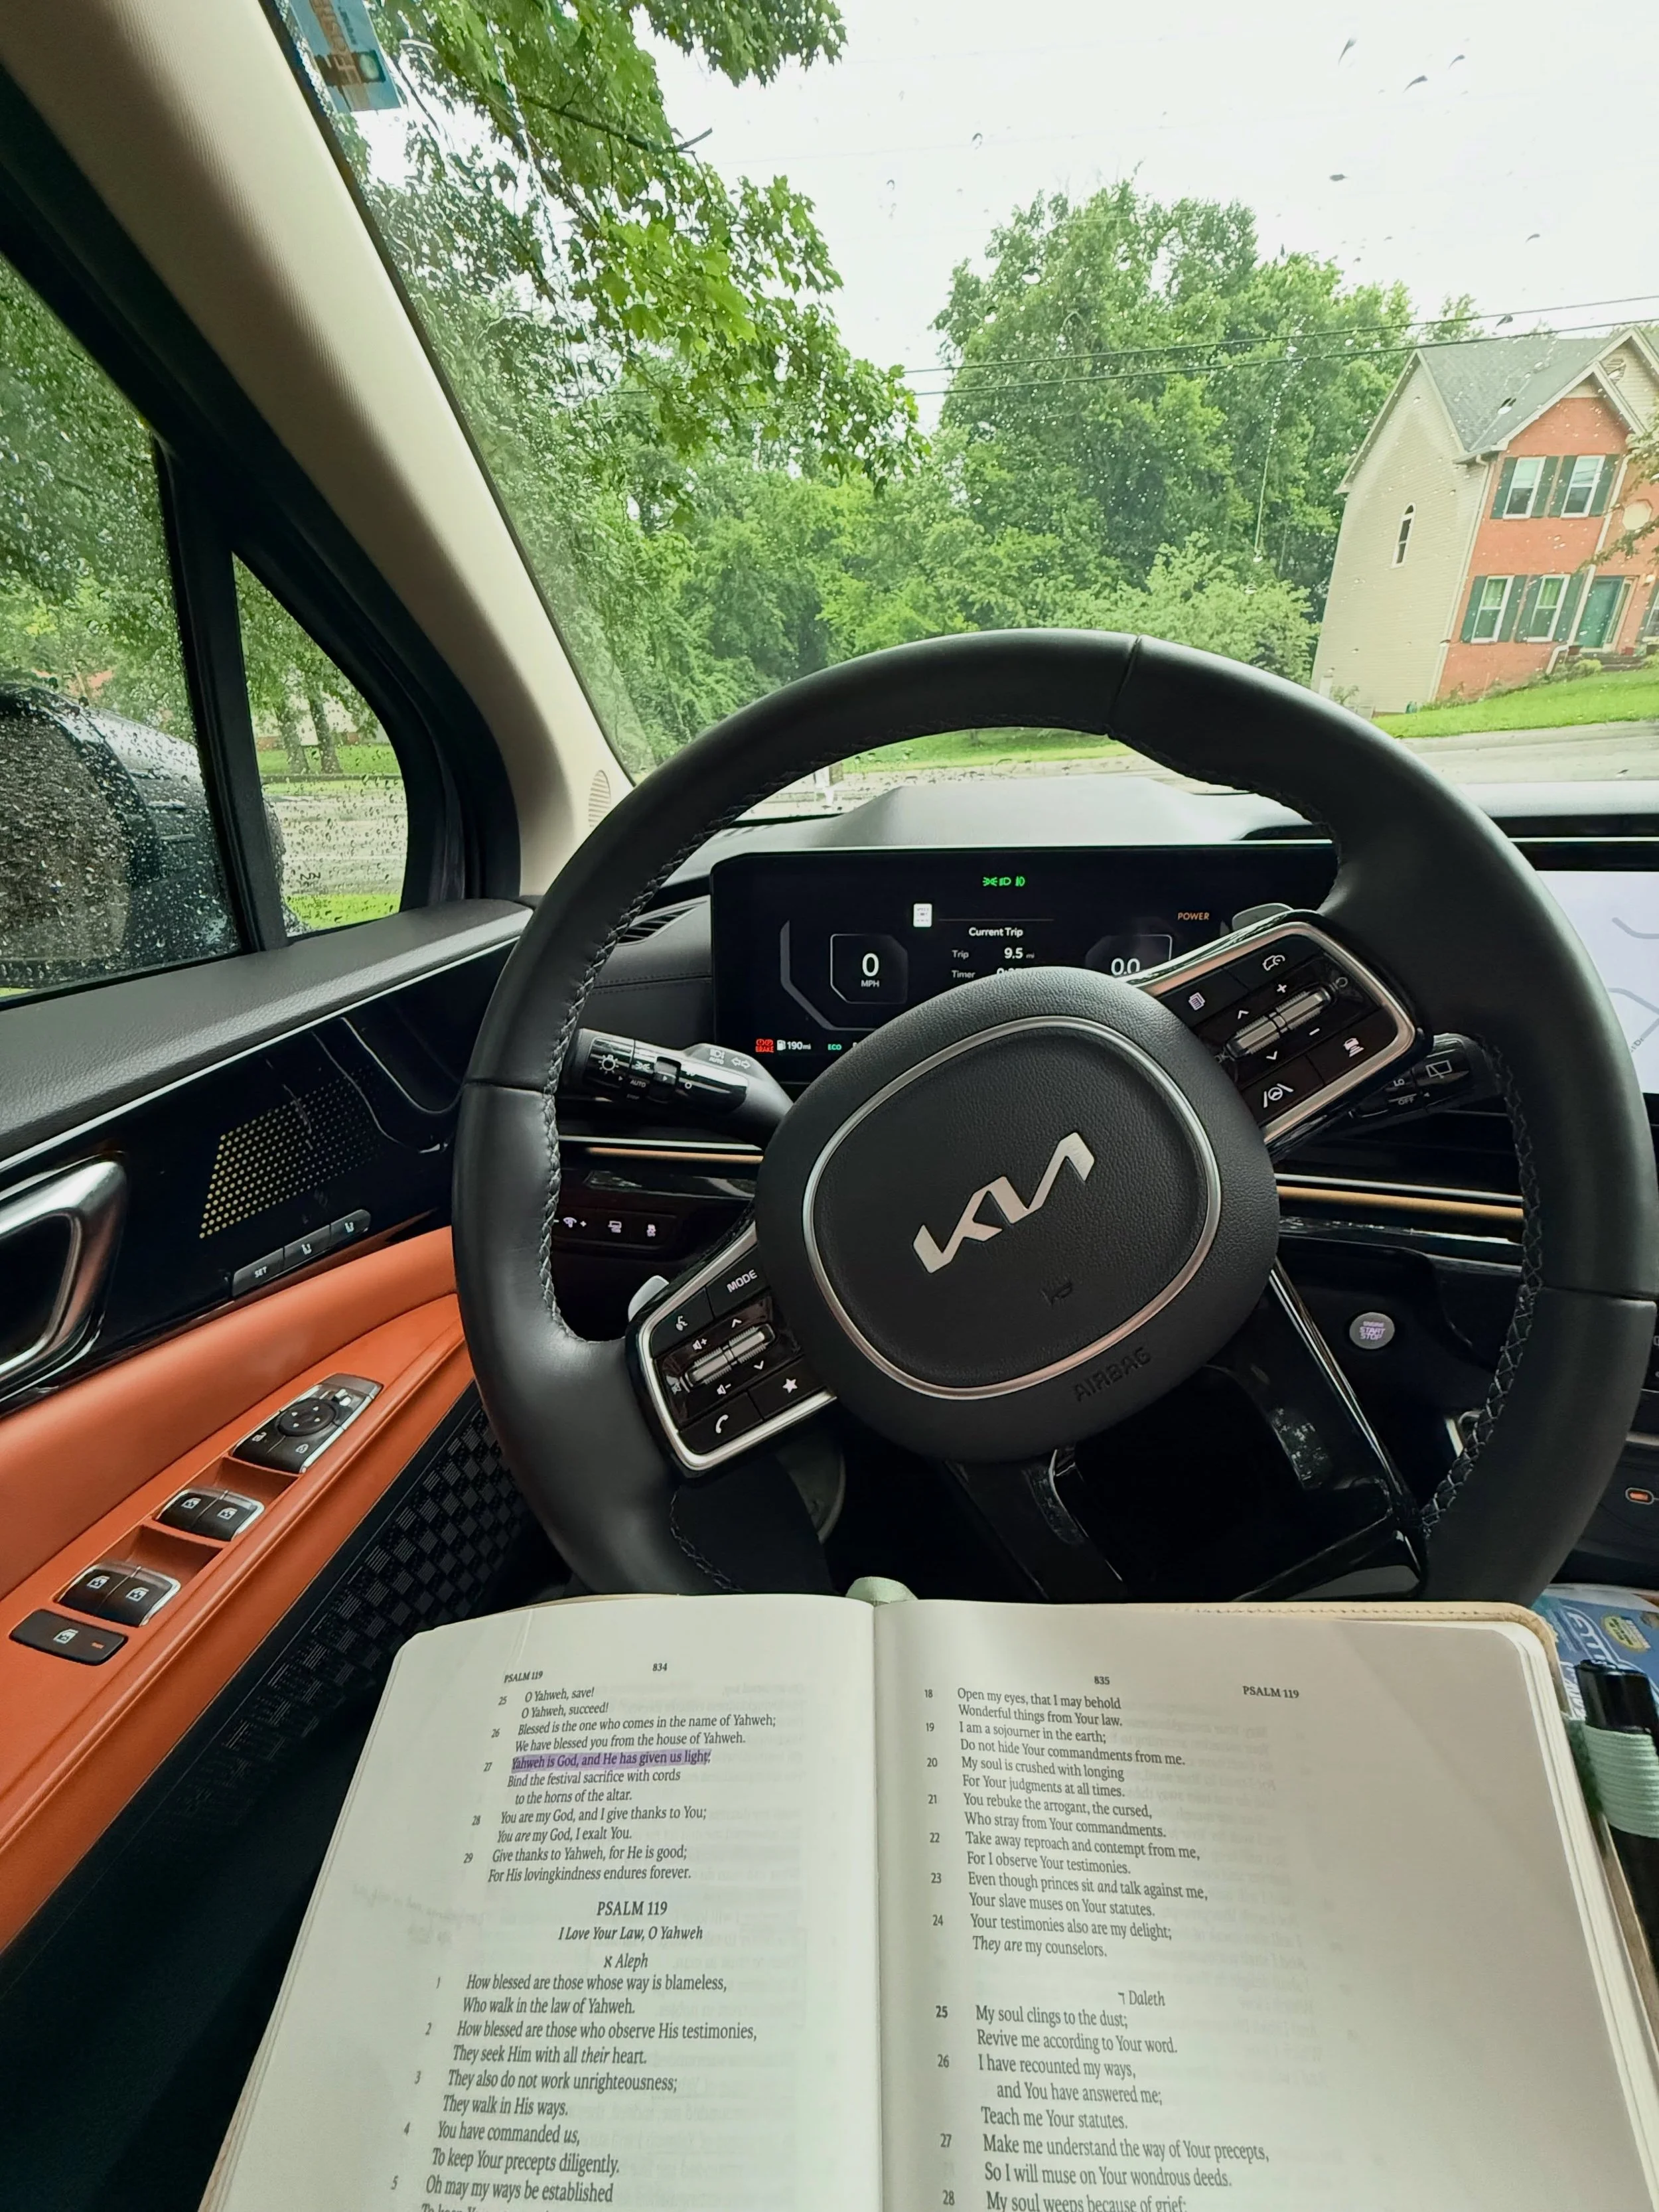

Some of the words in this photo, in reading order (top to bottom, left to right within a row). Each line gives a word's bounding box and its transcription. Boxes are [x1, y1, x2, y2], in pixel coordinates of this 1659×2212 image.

[1177, 912, 1210, 921] POWER
[968, 927, 1003, 936] Current
[1004, 927, 1023, 938] Trip
[952, 950, 969, 960] Trip
[1003, 947, 1023, 960] 9.5
[862, 952, 879, 977] 0
[1110, 958, 1141, 976] 0.0
[952, 970, 975, 979] Timer
[861, 979, 880, 988] MPH
[709, 1057, 725, 1065] AUTO
[630, 1079, 647, 1088] AUTO
[254, 1266, 267, 1278] SET
[726, 1269, 758, 1293] MODE
[1074, 1346, 1152, 1402] AIRBAG
[652, 1662, 668, 1672] 834
[503, 1670, 531, 1684] PSALM
[531, 1670, 543, 1680] 119
[1094, 1675, 1110, 1686] 835
[498, 1696, 508, 1706] 25
[524, 1691, 533, 1703] O
[534, 1688, 569, 1702] Yahweh,
[571, 1686, 595, 1699] save!
[924, 1688, 934, 1698] 18
[957, 1687, 985, 1702] Open
[987, 1692, 1002, 1705] my
[1004, 1694, 1029, 1706] eyes,
[1030, 1692, 1052, 1706] that
[1053, 1694, 1058, 1706] I
[1060, 1698, 1082, 1710] may
[1084, 1695, 1122, 1710] behold
[1242, 1685, 1281, 1698] PSALM
[1283, 1689, 1299, 1699] 119
[490, 1728, 500, 1739] 26
[517, 1720, 551, 1736] Blessed
[551, 1720, 560, 1733] is
[561, 1720, 577, 1733] the
[579, 1721, 598, 1732] one
[599, 1718, 621, 1730] who
[622, 1719, 654, 1730] comes
[656, 1716, 667, 1728] in
[669, 1715, 686, 1728] the
[687, 1717, 718, 1728] name
[719, 1714, 732, 1727] of
[733, 1713, 776, 1728] Yahweh;
[926, 1722, 935, 1732] 19
[960, 1738, 976, 1751] Do
[977, 1741, 996, 1753] not
[997, 1739, 1020, 1755] hide
[1021, 1743, 1045, 1757] Your
[1047, 1747, 1133, 1762] commandments
[1134, 1749, 1163, 1764] from
[1164, 1755, 1185, 1765] me.
[483, 1761, 493, 1772] 27
[511, 1755, 545, 1771] Yahweh
[546, 1754, 555, 1769] is
[557, 1753, 579, 1769] God,
[581, 1752, 601, 1766] and
[602, 1752, 618, 1765] He
[618, 1751, 638, 1765] has
[638, 1751, 668, 1767] given
[670, 1753, 682, 1763] us
[926, 1757, 938, 1767] 20
[928, 1793, 937, 1805] 21
[963, 1792, 984, 1806] You
[986, 1794, 1022, 1809] rebuke
[1024, 1796, 1041, 1810] the
[1043, 1801, 1090, 1816] arrogant,
[1092, 1801, 1110, 1815] the
[1112, 1804, 1153, 1819] cursed,
[471, 1815, 481, 1826] 28
[929, 1832, 940, 1843] 22
[965, 1830, 992, 1846] Take
[995, 1835, 1021, 1850] away
[1023, 1836, 1070, 1852] reproach
[1072, 1838, 1092, 1852] and
[1094, 1842, 1146, 1859] contempt
[1147, 1842, 1177, 1858] from
[1178, 1848, 1200, 1861] me,
[463, 1852, 474, 1864] 29
[487, 1868, 505, 1883] For
[505, 1867, 523, 1882] His
[524, 1866, 602, 1885] lovingkindness
[603, 1865, 648, 1880] endures
[649, 1864, 691, 1880] forever.
[930, 1872, 942, 1884] 23
[596, 1900, 645, 1917] PSALM
[647, 1901, 668, 1917] 119
[968, 1891, 996, 1907] Your
[998, 1893, 1027, 1909] slave
[1029, 1898, 1064, 1911] muses
[1065, 1901, 1080, 1912] on
[1081, 1898, 1107, 1914] Your
[1109, 1903, 1155, 1917] statutes.
[932, 1914, 944, 1926] 24
[557, 1926, 565, 1941] I
[564, 1926, 591, 1941] Love
[593, 1926, 618, 1941] Your
[618, 1926, 645, 1943] Law,
[648, 1925, 658, 1941] O
[660, 1925, 703, 1940] Yahweh
[972, 1935, 1001, 1955] They
[1004, 1940, 1023, 1952] are
[1024, 1941, 1043, 1957] my
[1045, 1940, 1108, 1957] counselors.
[614, 1952, 648, 1973] Aleph
[436, 1976, 441, 1989] 1
[466, 1974, 491, 1990] How
[492, 1973, 532, 1990] blessed
[532, 1978, 551, 1990] are
[552, 1974, 584, 1990] those
[586, 1973, 624, 1990] whose
[626, 1978, 650, 1994] way
[652, 1974, 662, 1990] is
[665, 1973, 727, 1993] blameless,
[1128, 1990, 1166, 2007] Daleth
[935, 2005, 948, 2019] 25
[976, 2028, 1018, 2047] Revive
[1021, 2035, 1040, 2048] me
[1043, 2032, 1100, 2055] according
[1101, 2037, 1114, 2051] to
[1115, 2035, 1142, 2052] Your
[1144, 2036, 1178, 2053] word.
[937, 2053, 950, 2069] 26
[414, 2070, 421, 2085] 3
[448, 2068, 476, 2091] They
[475, 2069, 499, 2088] also
[500, 2069, 516, 2089] do
[517, 2074, 538, 2089] not
[541, 2071, 571, 2090] work
[573, 2071, 678, 2095] unrighteousness;
[403, 2122, 411, 2136] 4
[940, 2133, 952, 2148] 27
[982, 2133, 1020, 2154] Make
[1023, 2140, 1043, 2155] me
[1046, 2136, 1118, 2157] understand
[1119, 2138, 1140, 2157] the
[1142, 2144, 1165, 2162] way
[1169, 2139, 1181, 2158] of
[1182, 2140, 1211, 2159] Your
[1213, 2145, 1269, 2165] precepts,
[390, 2175, 399, 2190] 5
